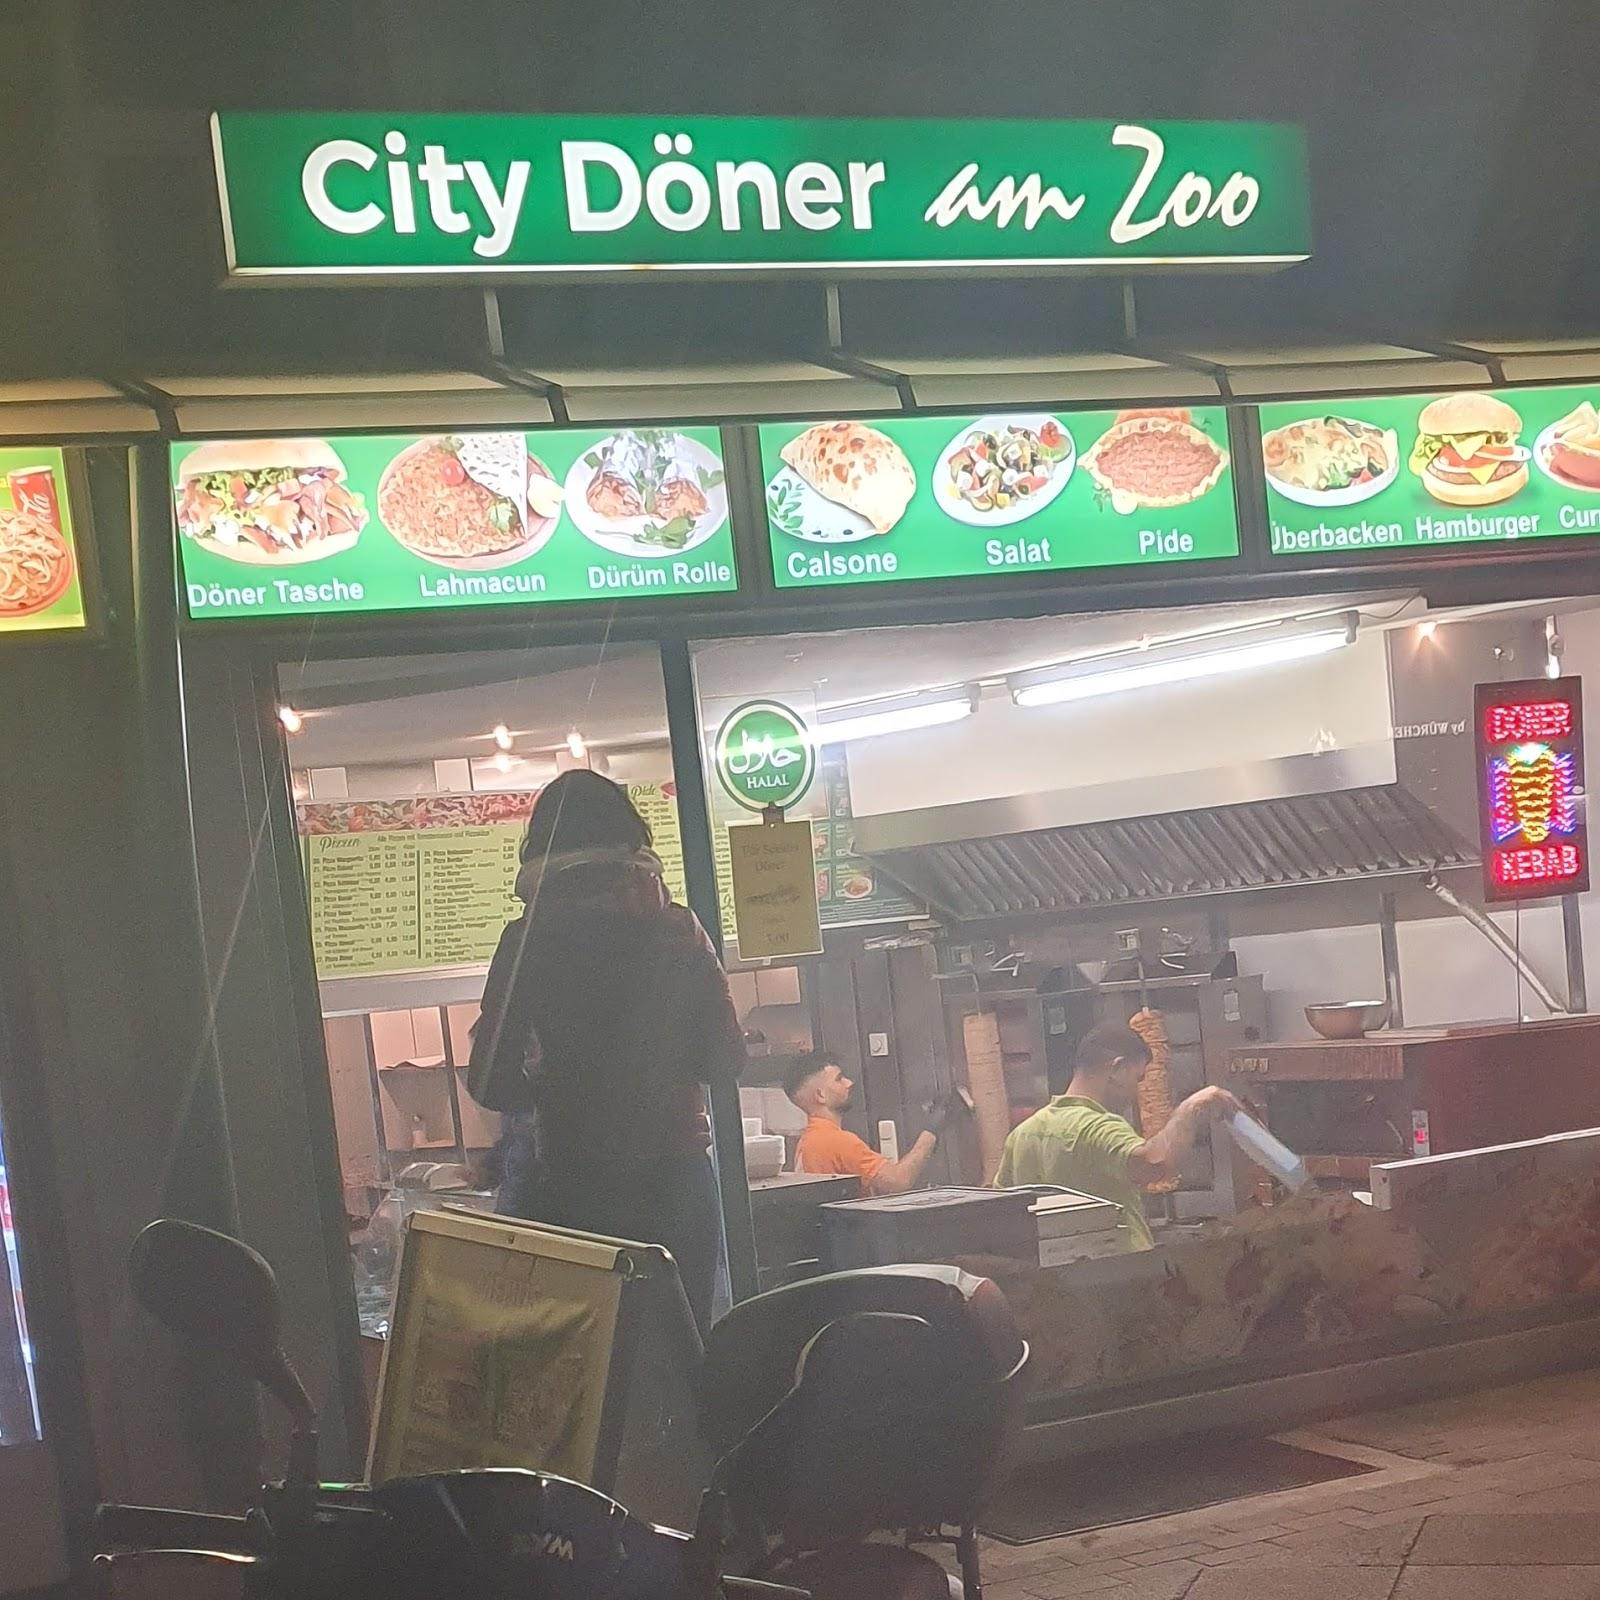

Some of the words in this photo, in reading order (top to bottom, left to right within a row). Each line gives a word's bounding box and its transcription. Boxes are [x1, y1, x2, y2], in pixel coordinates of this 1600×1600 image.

[301, 130, 531, 258] City
[561, 132, 886, 234] Döner
[923, 162, 1086, 231] am
[1109, 124, 1260, 244] Zoo
[1415, 513, 1541, 541] Hamburger
[1558, 504, 1600, 529] Cur
[985, 536, 1052, 566] Salat
[1138, 527, 1195, 556] Pide
[587, 562, 666, 590] Dürüm
[673, 560, 731, 585] Rolle
[787, 550, 898, 579] Calsone
[187, 580, 266, 609] Döner
[272, 576, 366, 605] Tasche
[418, 572, 547, 599] Lahmacun
[746, 773, 790, 789] HALAL
[1500, 845, 1580, 882] KEBAB
